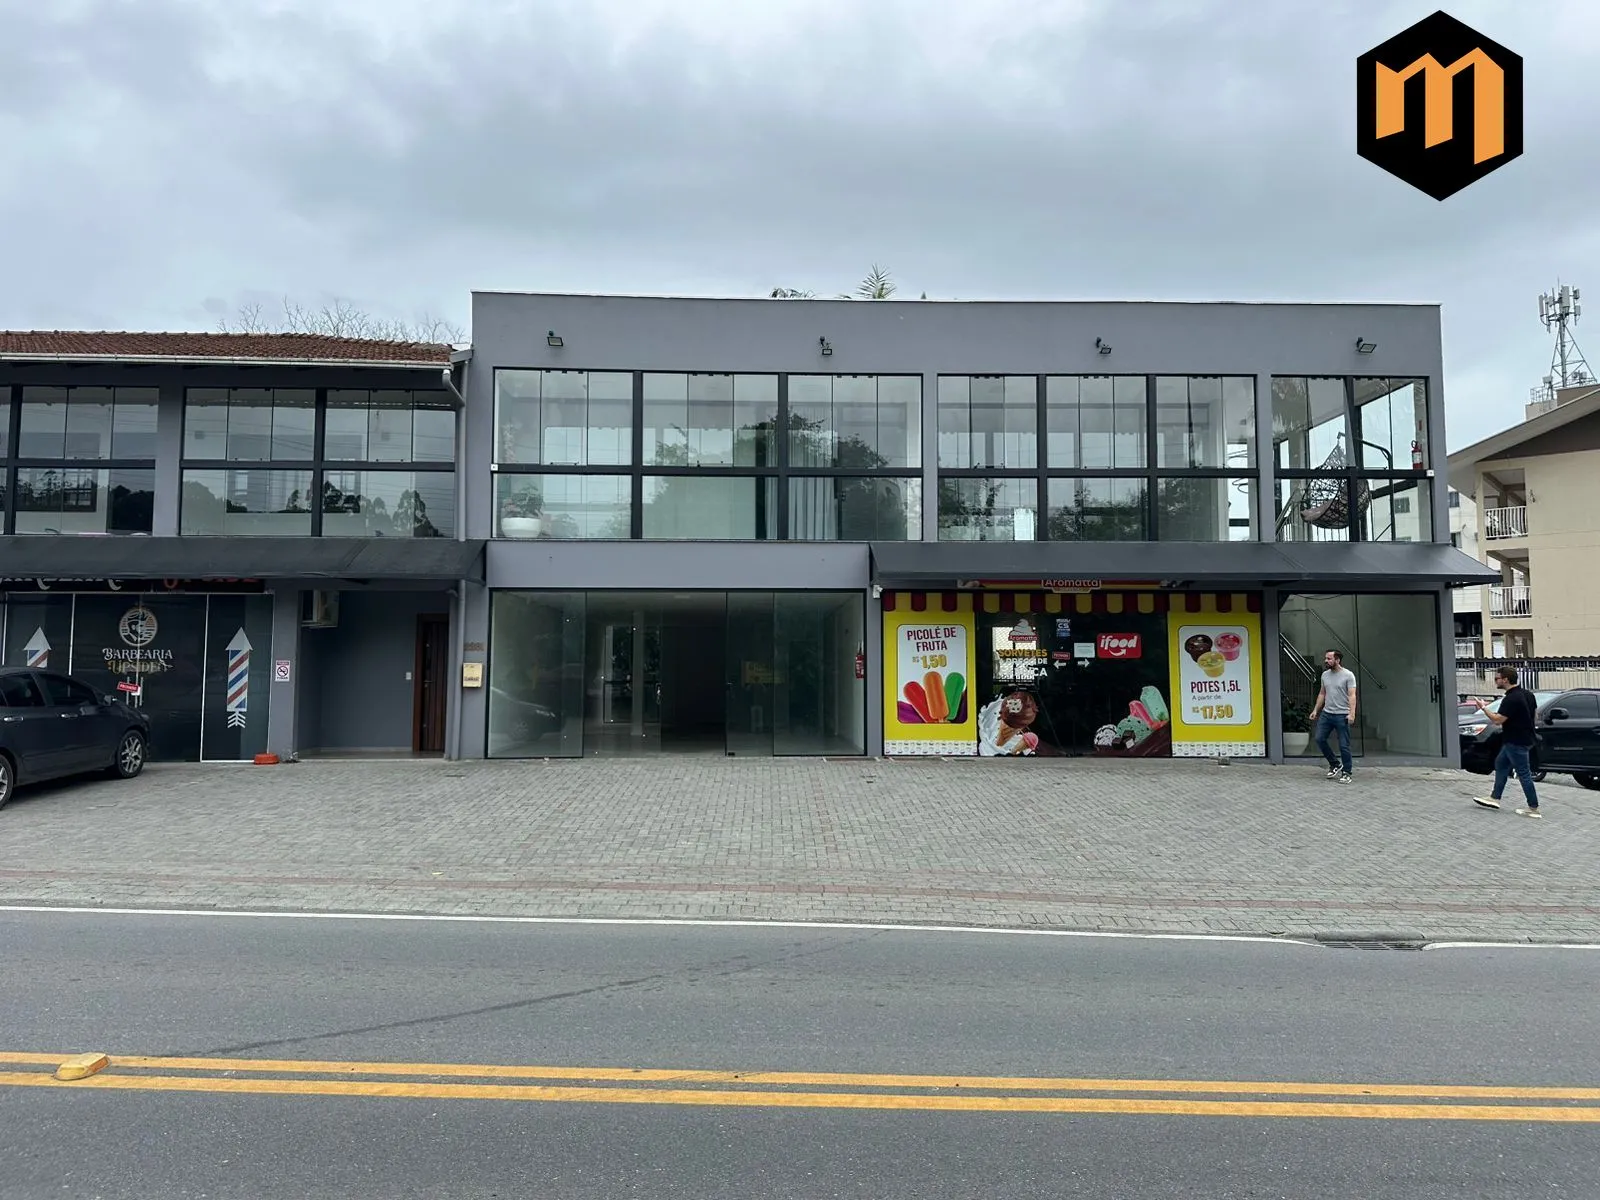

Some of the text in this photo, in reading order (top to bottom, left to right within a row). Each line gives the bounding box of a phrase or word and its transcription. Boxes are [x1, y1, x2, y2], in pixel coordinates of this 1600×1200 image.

[906, 626, 957, 641] PICOLÉ DE
[916, 640, 948, 652] FRUTA
[998, 648, 1048, 657] SORVETES
[920, 653, 947, 669] 1,50
[1190, 679, 1242, 693] POTES 1,5L
[1200, 704, 1233, 720] 17,50
